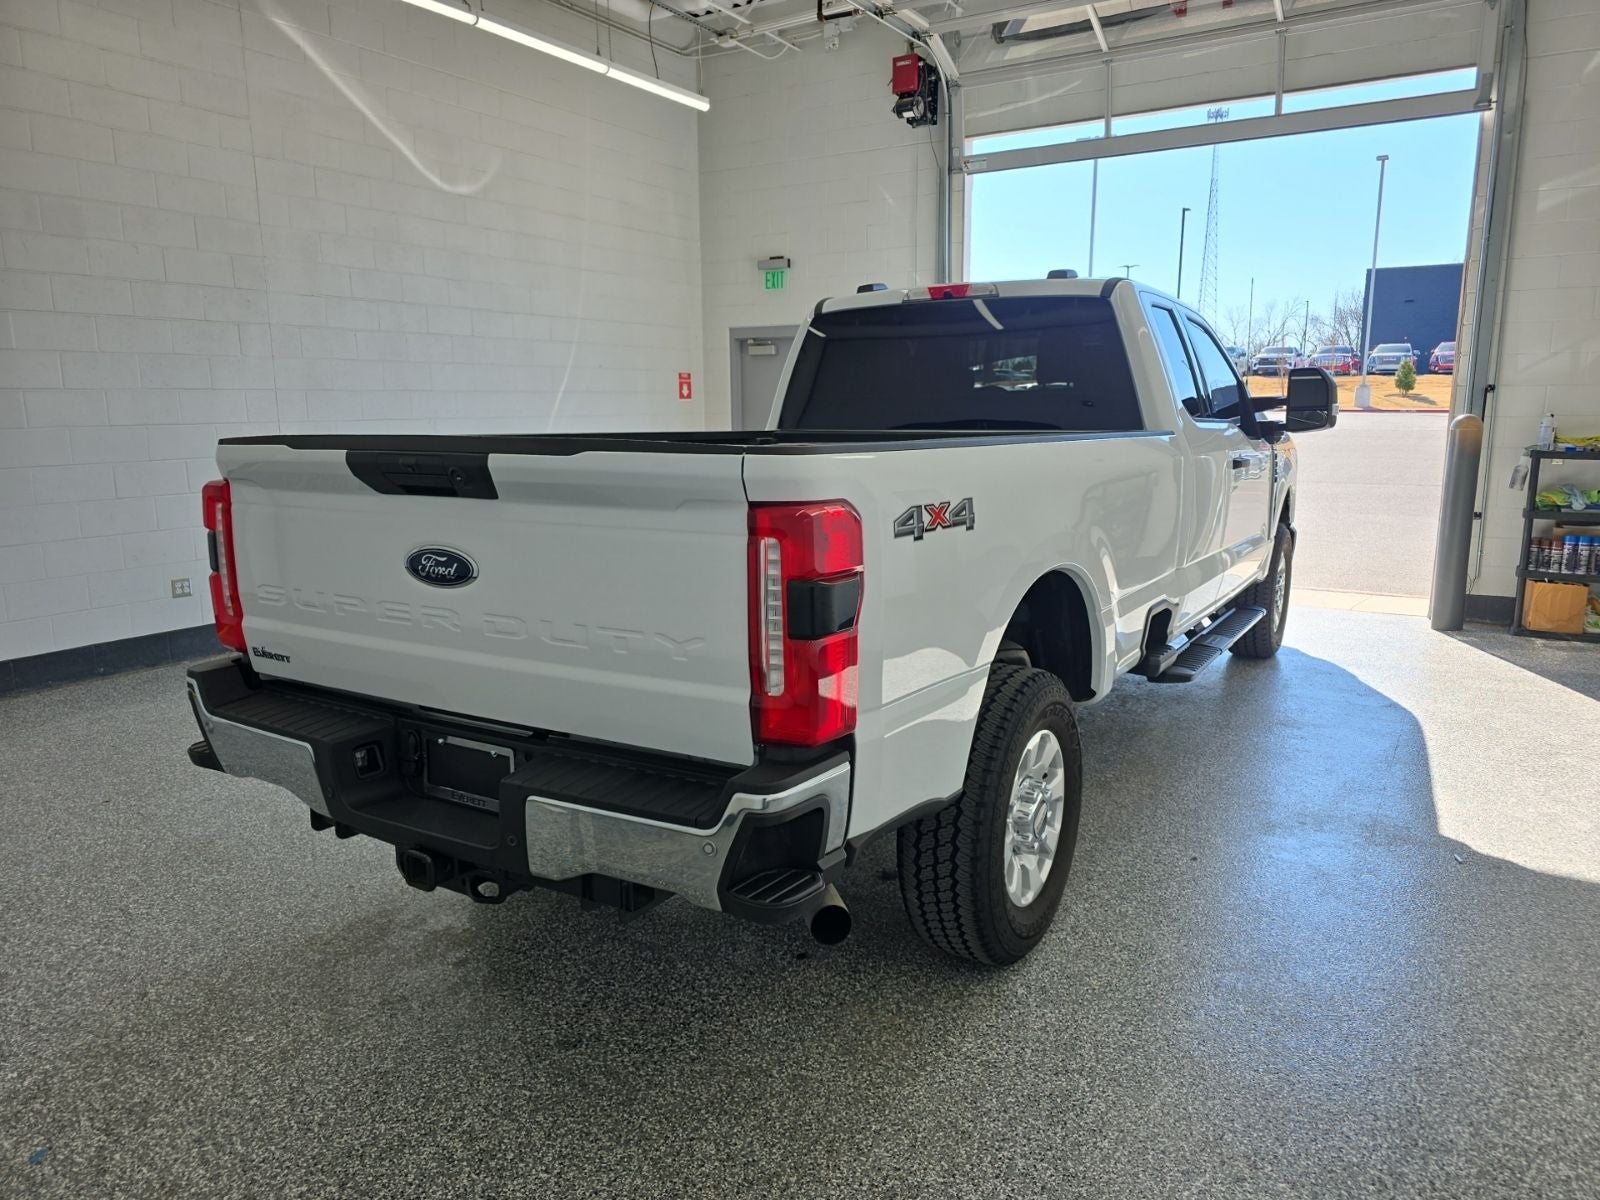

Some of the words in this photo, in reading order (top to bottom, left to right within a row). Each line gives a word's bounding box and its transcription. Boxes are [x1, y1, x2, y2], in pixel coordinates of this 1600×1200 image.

[765, 271, 784, 289] EXIT
[418, 554, 458, 579] Ford
[257, 583, 461, 632] SUPER
[482, 612, 705, 661] DUTY
